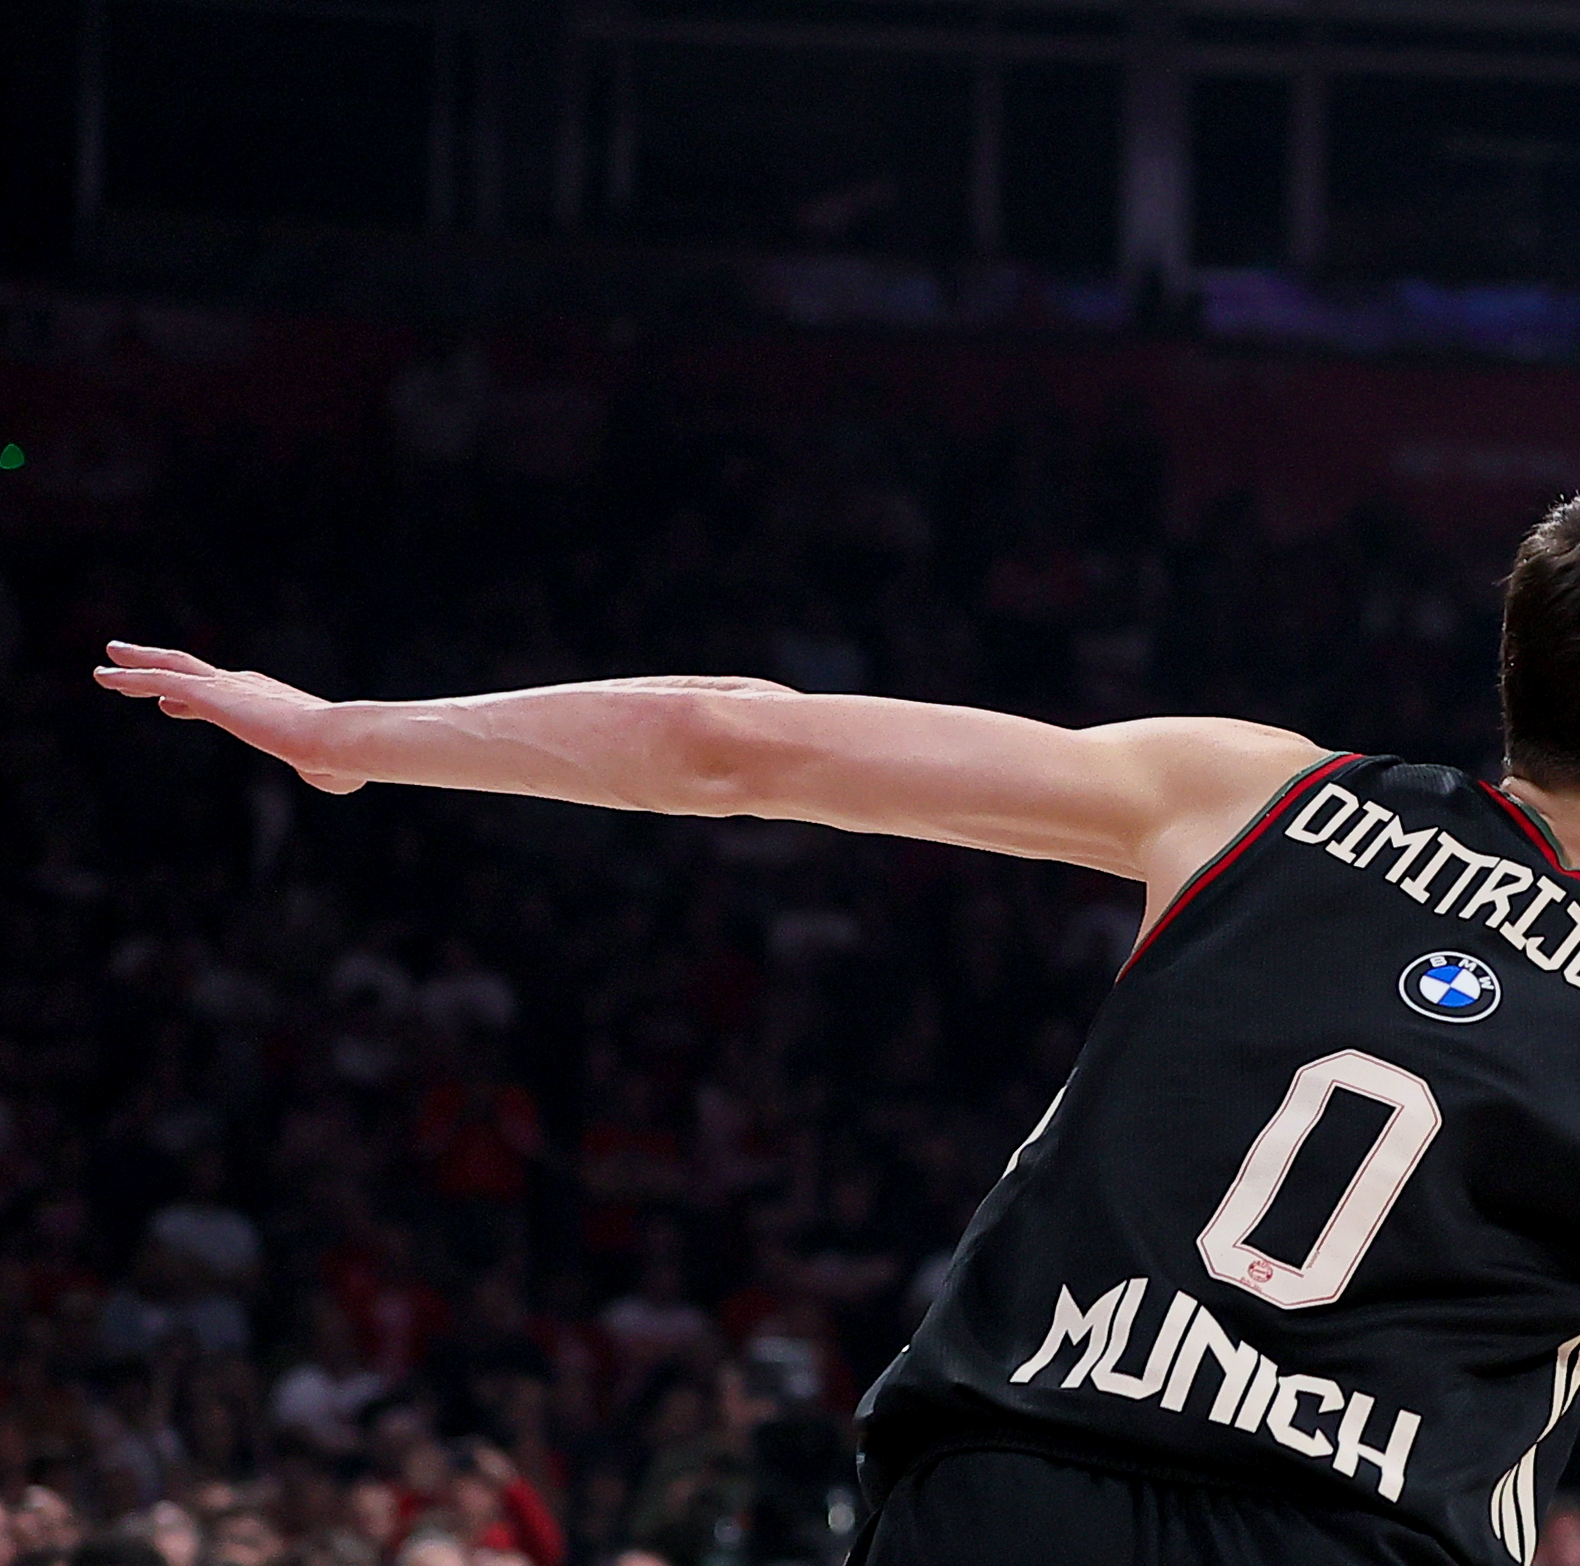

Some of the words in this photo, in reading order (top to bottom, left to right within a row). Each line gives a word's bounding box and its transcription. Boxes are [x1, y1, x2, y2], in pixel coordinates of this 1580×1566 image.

[1429, 955, 1495, 990] BMW
[1196, 1047, 1444, 1310] 0
[1009, 1277, 1421, 1503] MUNICH
